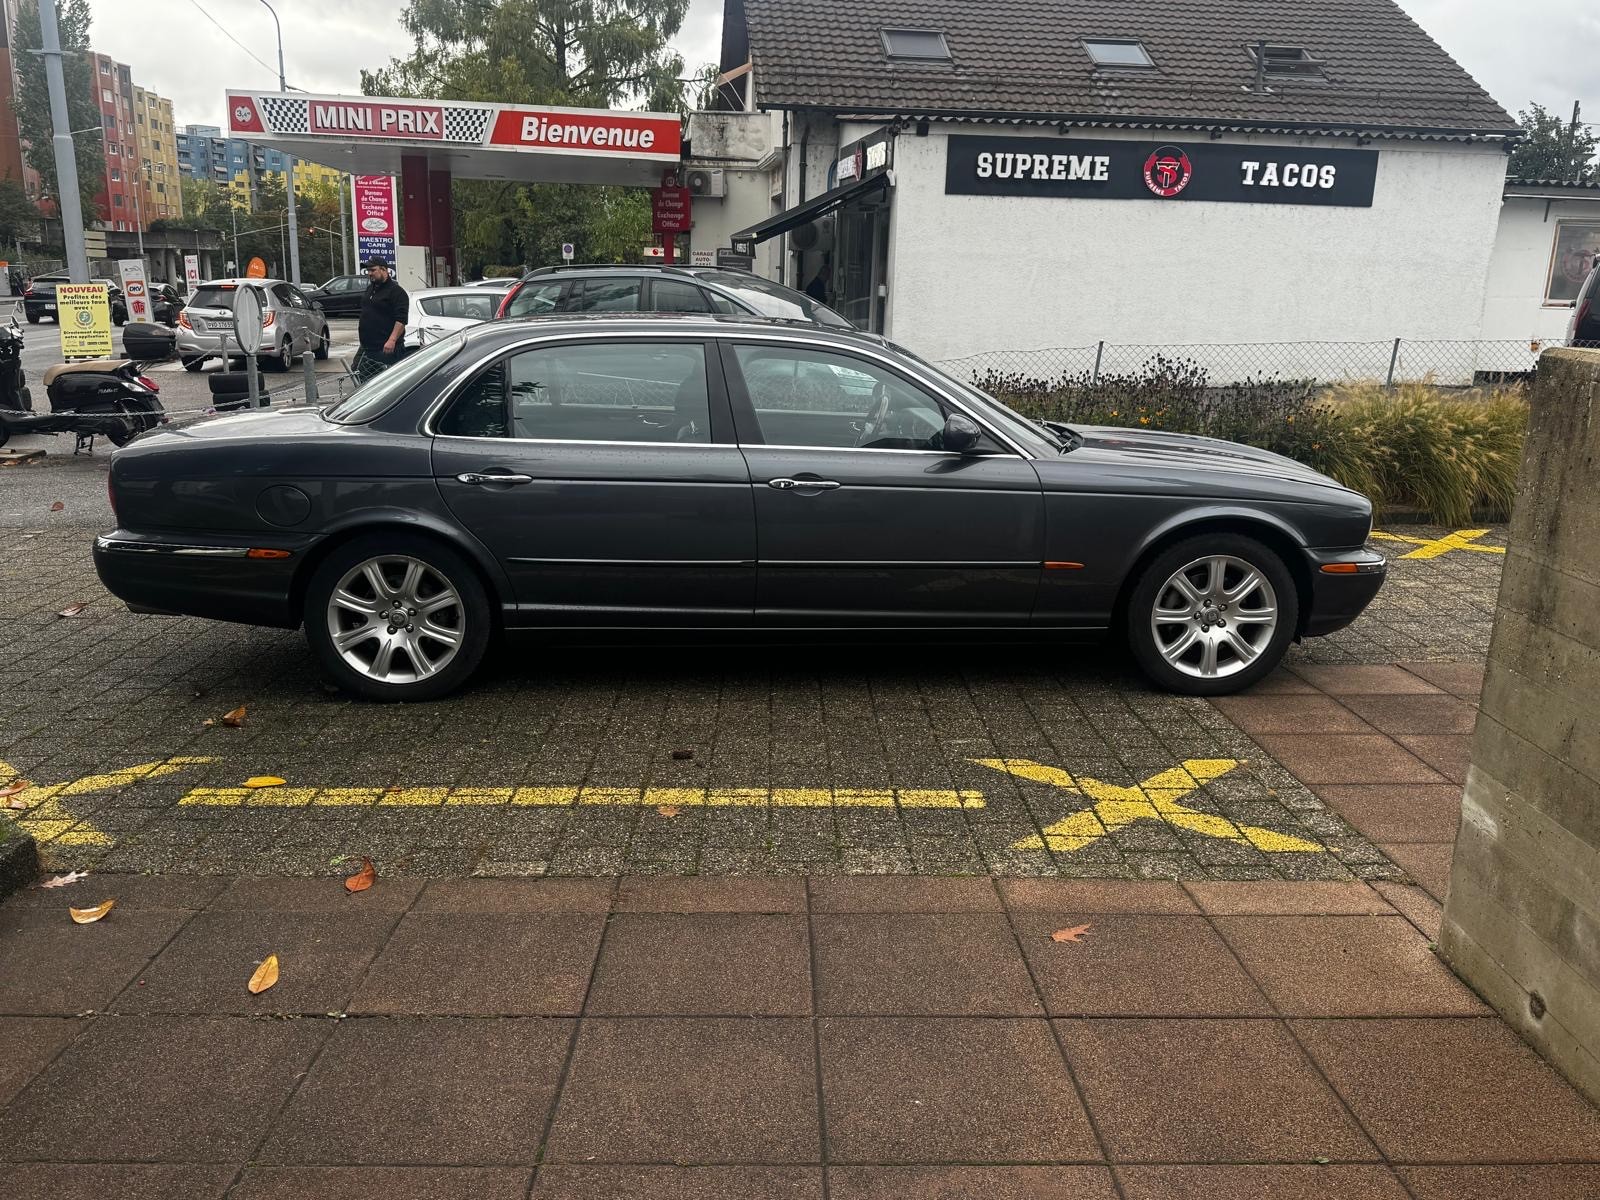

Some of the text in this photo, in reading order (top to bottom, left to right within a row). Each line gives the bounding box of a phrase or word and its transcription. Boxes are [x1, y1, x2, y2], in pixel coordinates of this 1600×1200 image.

[315, 105, 440, 134] MINI PRIX
[521, 116, 655, 148] Bienvenue
[976, 152, 1110, 181] SUPREME
[1241, 161, 1336, 189] TACOS
[657, 212, 684, 220] Exchange
[665, 200, 684, 208] Change
[188, 270, 197, 279] ICI
